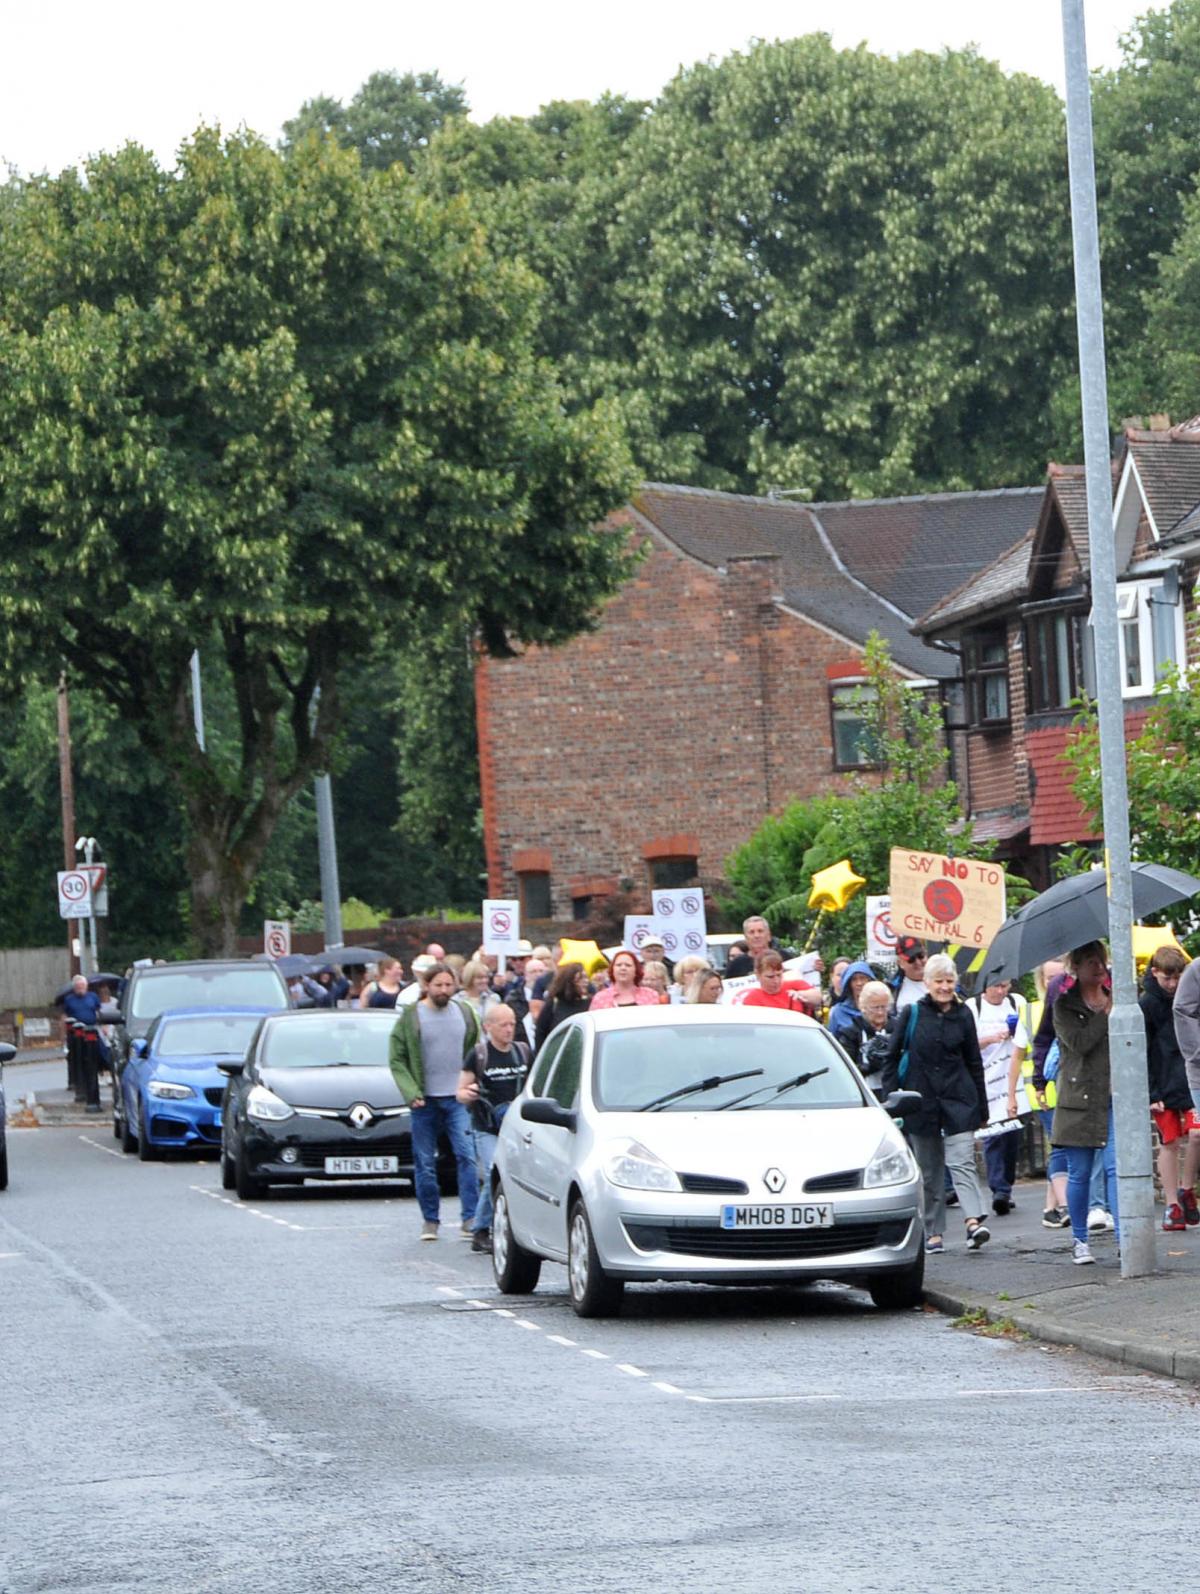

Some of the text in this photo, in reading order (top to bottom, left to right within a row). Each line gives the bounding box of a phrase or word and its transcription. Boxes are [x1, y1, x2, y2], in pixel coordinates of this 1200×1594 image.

[908, 855, 999, 885] SAY NO TO
[65, 881, 83, 894] 30
[904, 914, 984, 943] CENTRAL 6
[333, 1159, 390, 1171] HT16 VLB
[736, 1207, 827, 1225] MH08 DGY
